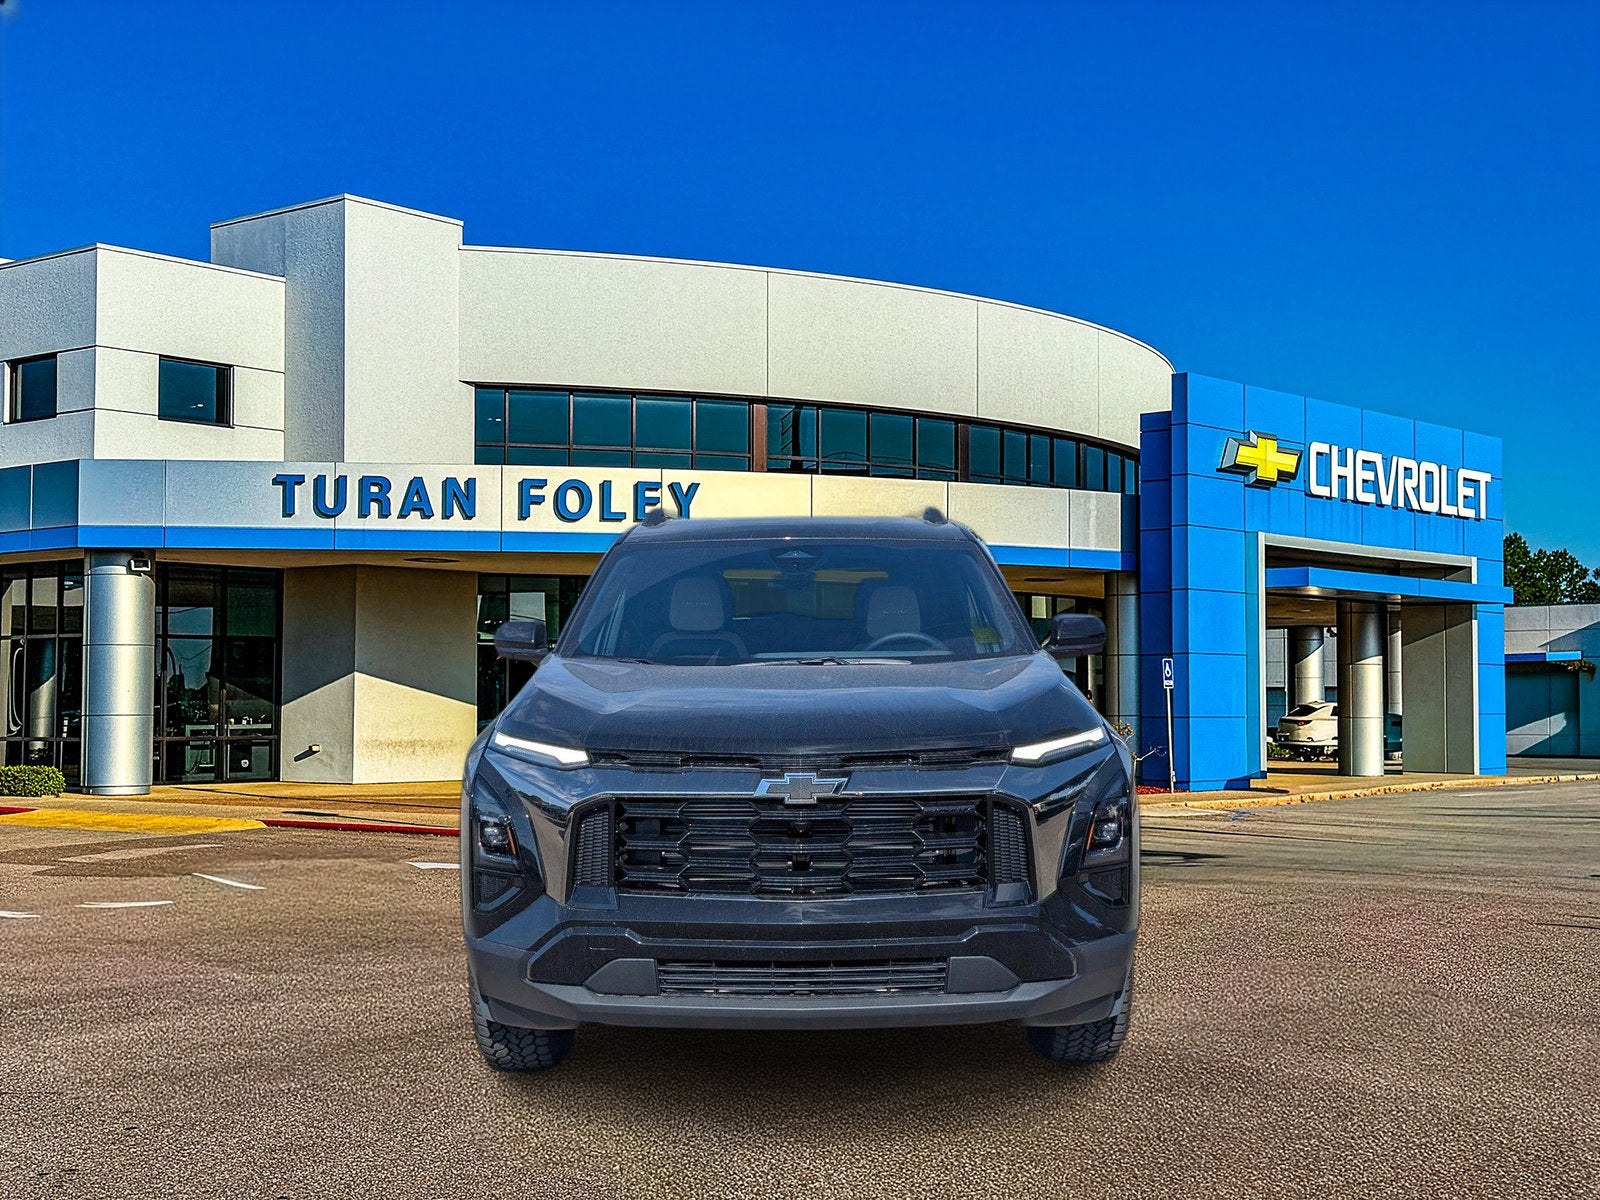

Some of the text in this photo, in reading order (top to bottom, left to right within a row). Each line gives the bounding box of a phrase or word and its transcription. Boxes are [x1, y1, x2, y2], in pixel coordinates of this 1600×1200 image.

[272, 474, 701, 522] TURAN FOLEY
[1307, 441, 1492, 520] CHEVROLET
